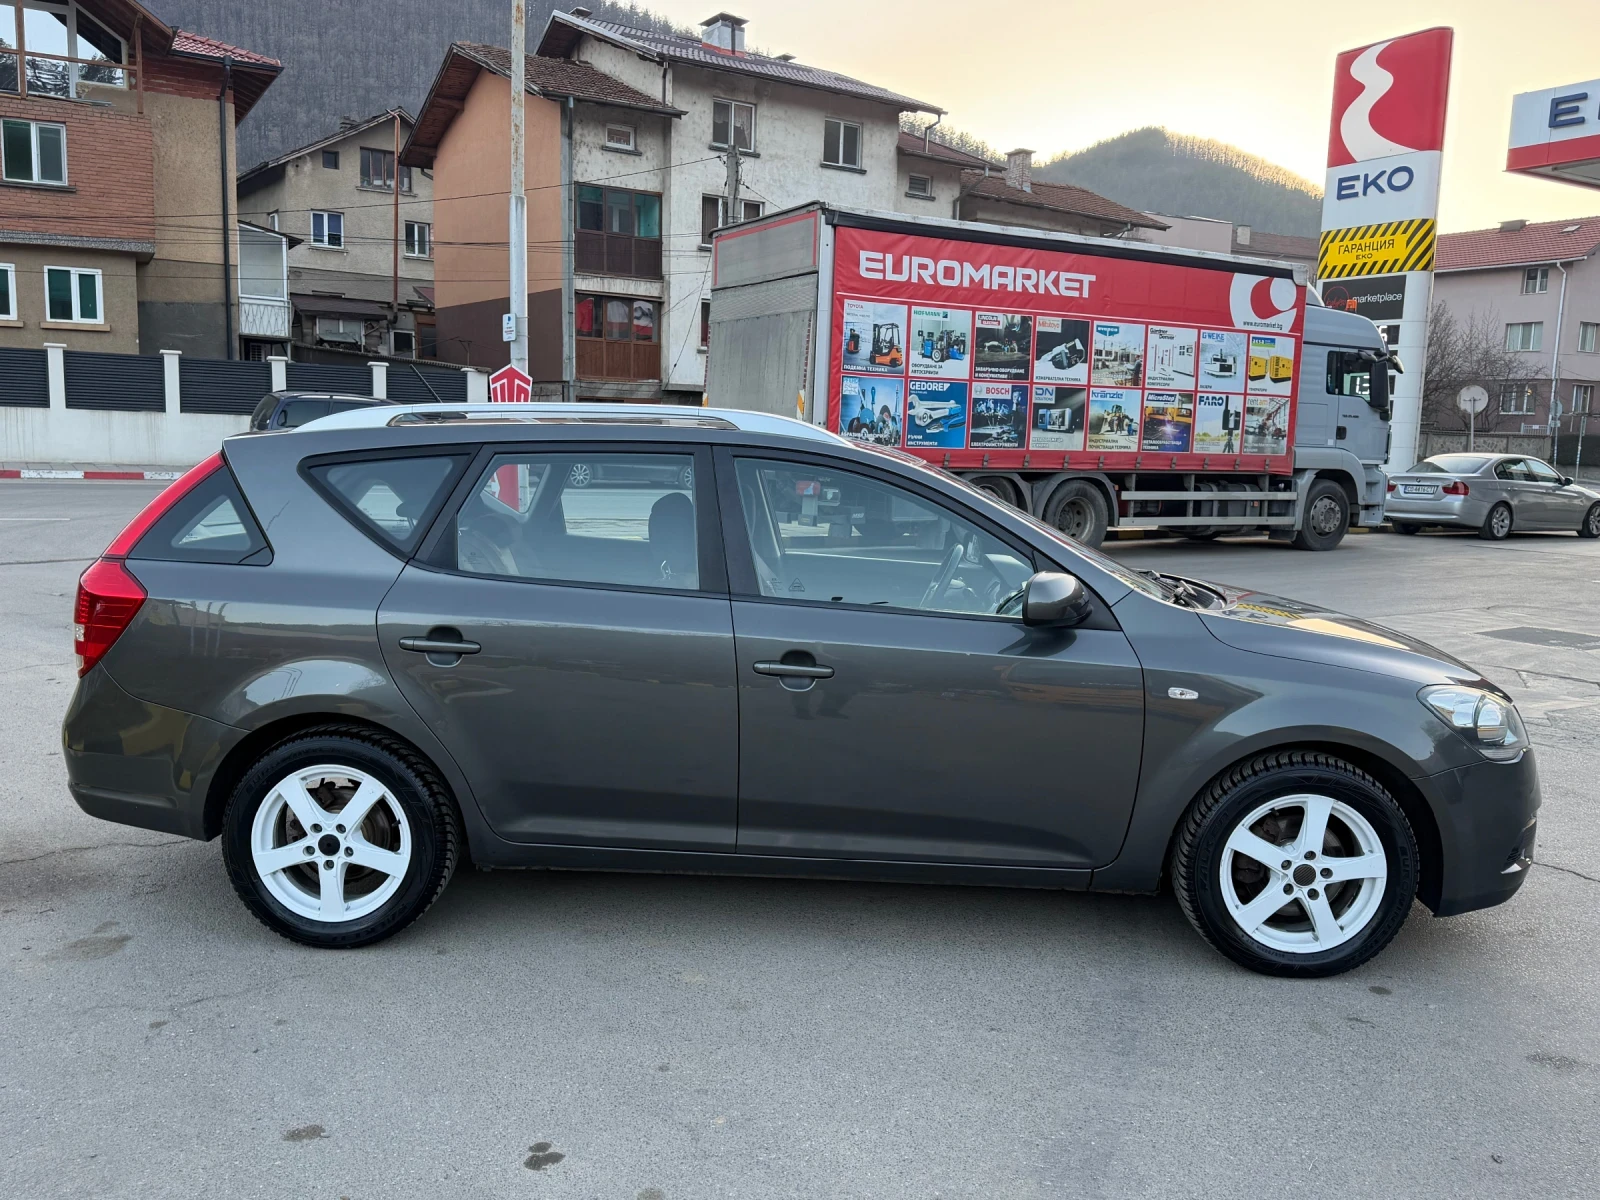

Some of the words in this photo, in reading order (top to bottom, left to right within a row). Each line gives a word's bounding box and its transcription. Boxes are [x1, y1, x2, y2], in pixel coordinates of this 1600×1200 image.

[1548, 92, 1600, 129] E
[1337, 166, 1414, 201] EKO
[1338, 239, 1395, 255] ГАРАНЦИЯ
[859, 250, 1097, 299] EUROMARKET
[1352, 292, 1403, 304] marketplace
[1243, 320, 1283, 331] www.euromarket.bg
[909, 381, 945, 391] GEDORE
[985, 386, 1010, 395] BOSCH
[1035, 387, 1054, 397] DN
[1147, 393, 1175, 402] MicroStep
[1198, 395, 1224, 407] FARO
